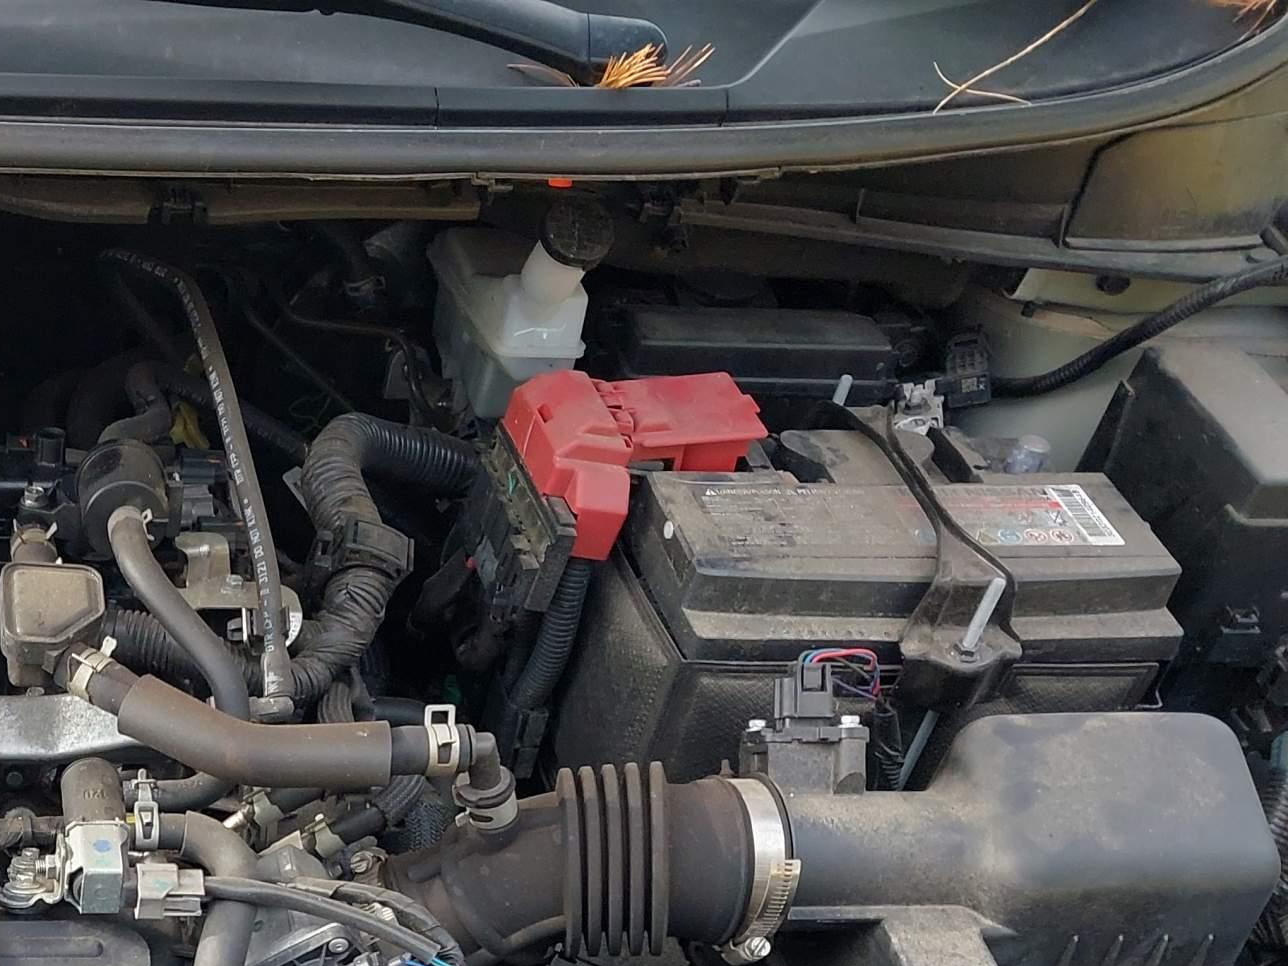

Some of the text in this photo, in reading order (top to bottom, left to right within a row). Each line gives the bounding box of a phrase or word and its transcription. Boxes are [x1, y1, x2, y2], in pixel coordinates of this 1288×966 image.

[243, 505, 256, 529] KINK
[249, 530, 261, 545] NOT
[253, 547, 264, 559] DO
